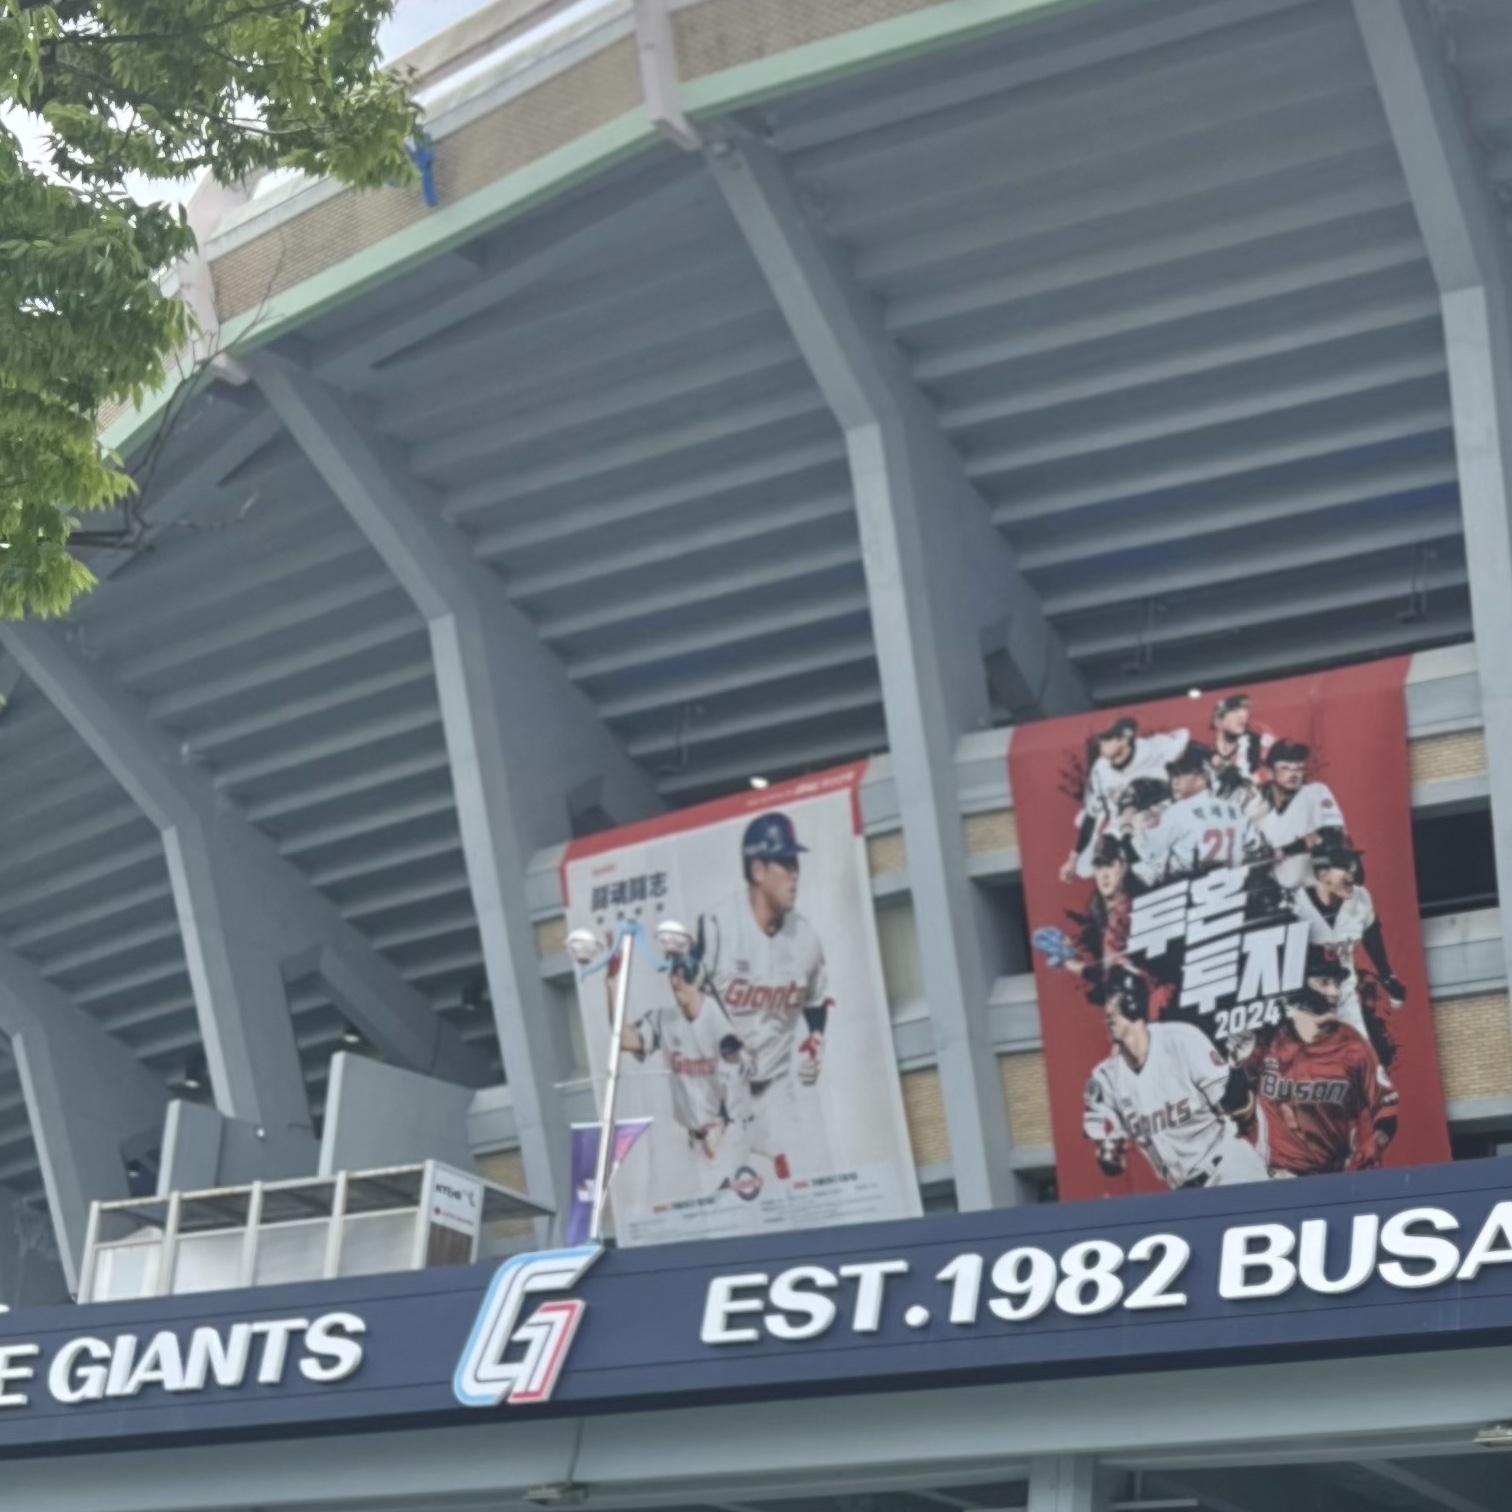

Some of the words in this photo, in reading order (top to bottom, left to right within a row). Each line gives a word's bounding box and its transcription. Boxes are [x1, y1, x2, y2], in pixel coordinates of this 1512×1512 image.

[1178, 920, 1310, 1016] 투지
[1214, 1000, 1281, 1040] 2024
[1260, 1072, 1350, 1103] Busan
[48, 1312, 366, 1404] GIANTS
